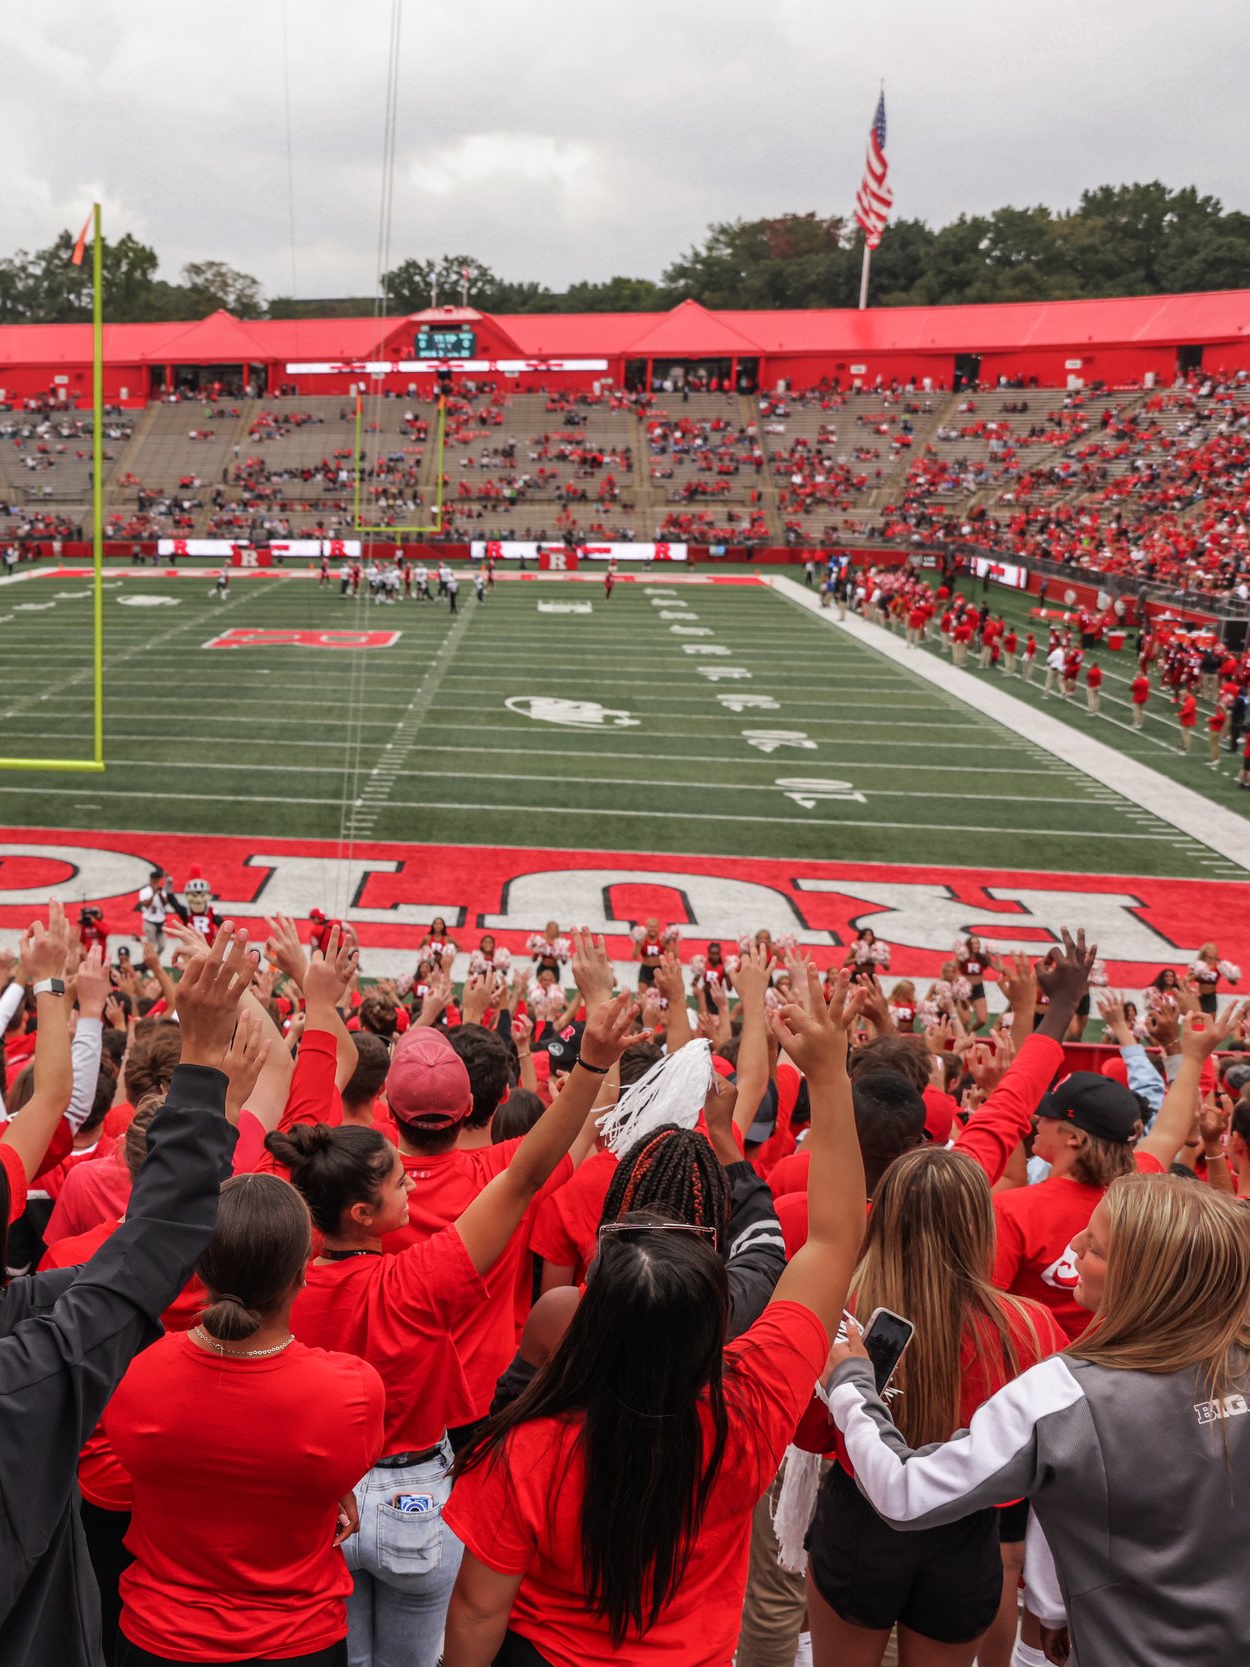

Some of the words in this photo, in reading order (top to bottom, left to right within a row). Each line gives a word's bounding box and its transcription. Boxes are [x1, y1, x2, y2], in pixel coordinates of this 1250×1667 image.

[174, 540, 189, 556] R
[329, 540, 345, 557] R
[654, 542, 672, 560] R
[240, 550, 259, 567] R
[549, 554, 567, 570] R
[193, 915, 210, 934] R
[967, 962, 981, 974] R
[559, 1024, 576, 1042] R
